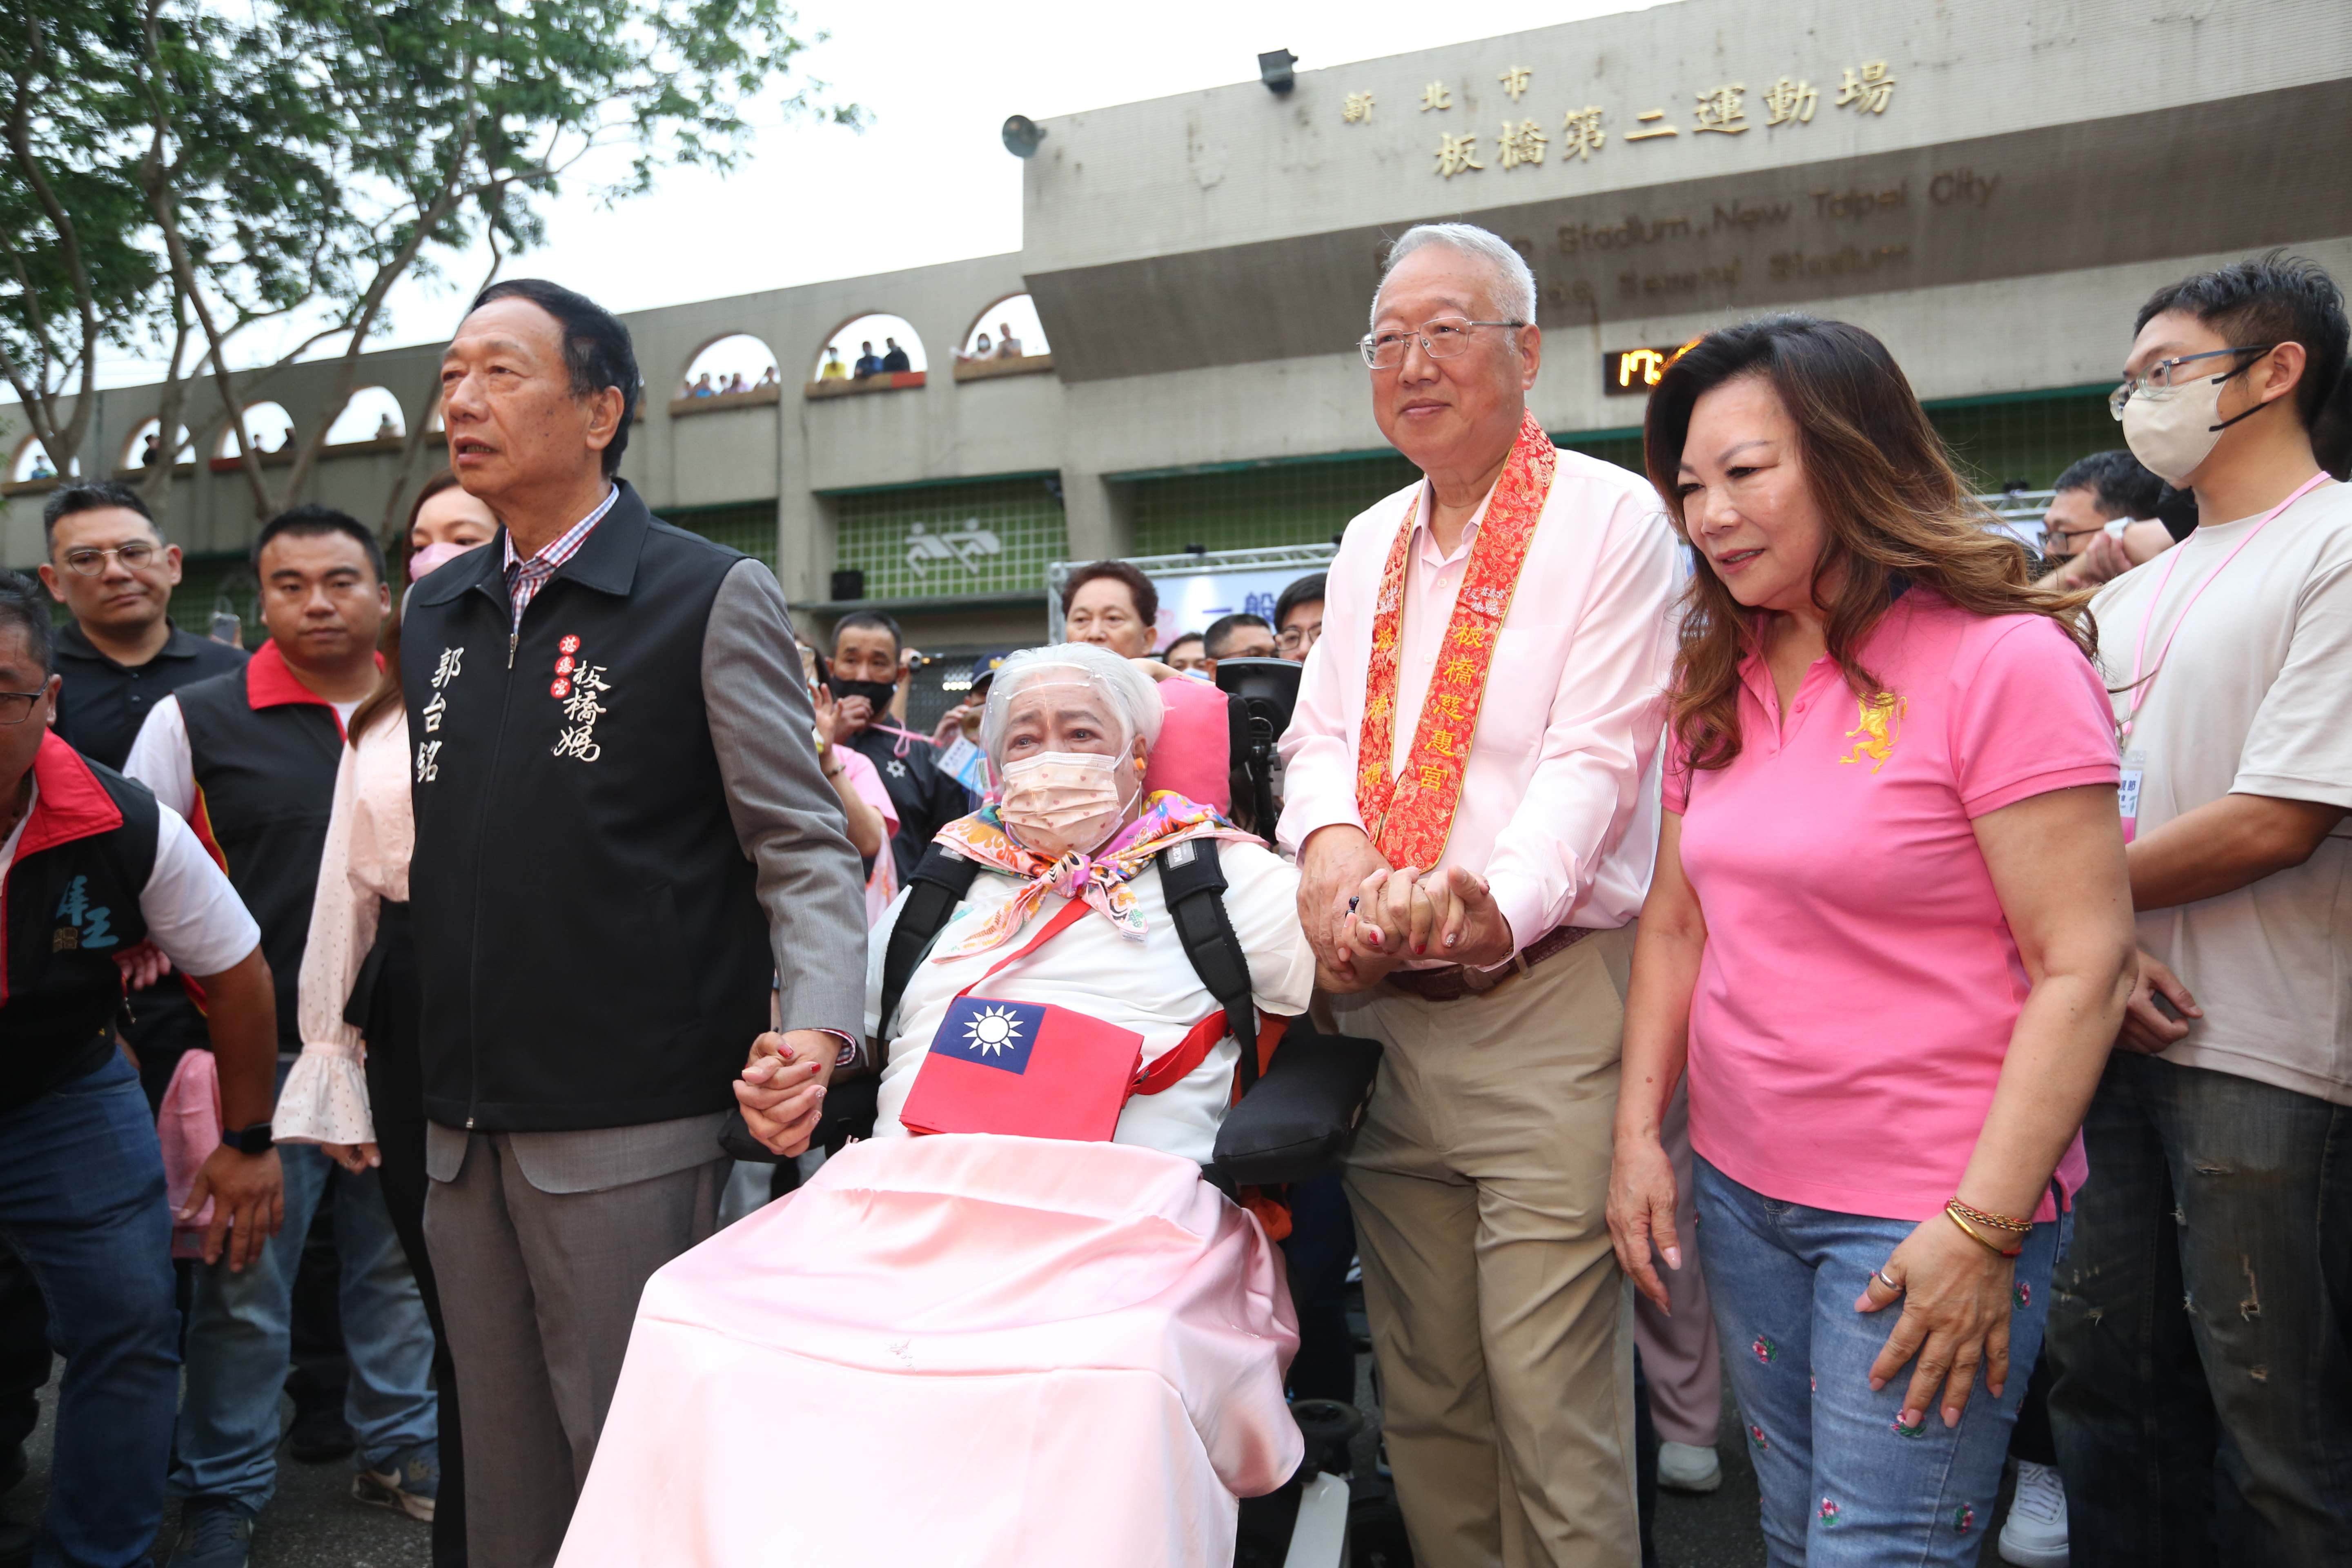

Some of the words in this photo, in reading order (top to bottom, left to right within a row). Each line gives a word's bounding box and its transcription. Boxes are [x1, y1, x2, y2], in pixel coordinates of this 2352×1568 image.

[1342, 65, 1533, 124] 新北市
[1433, 60, 1897, 179] 板橋第二運動場
[1929, 168, 2000, 207] City
[416, 647, 464, 783] 郭台銘
[552, 635, 578, 697] 慈惠宮
[553, 660, 611, 762] 板橋媽
[1420, 622, 1485, 791] 板橋慈惠宮
